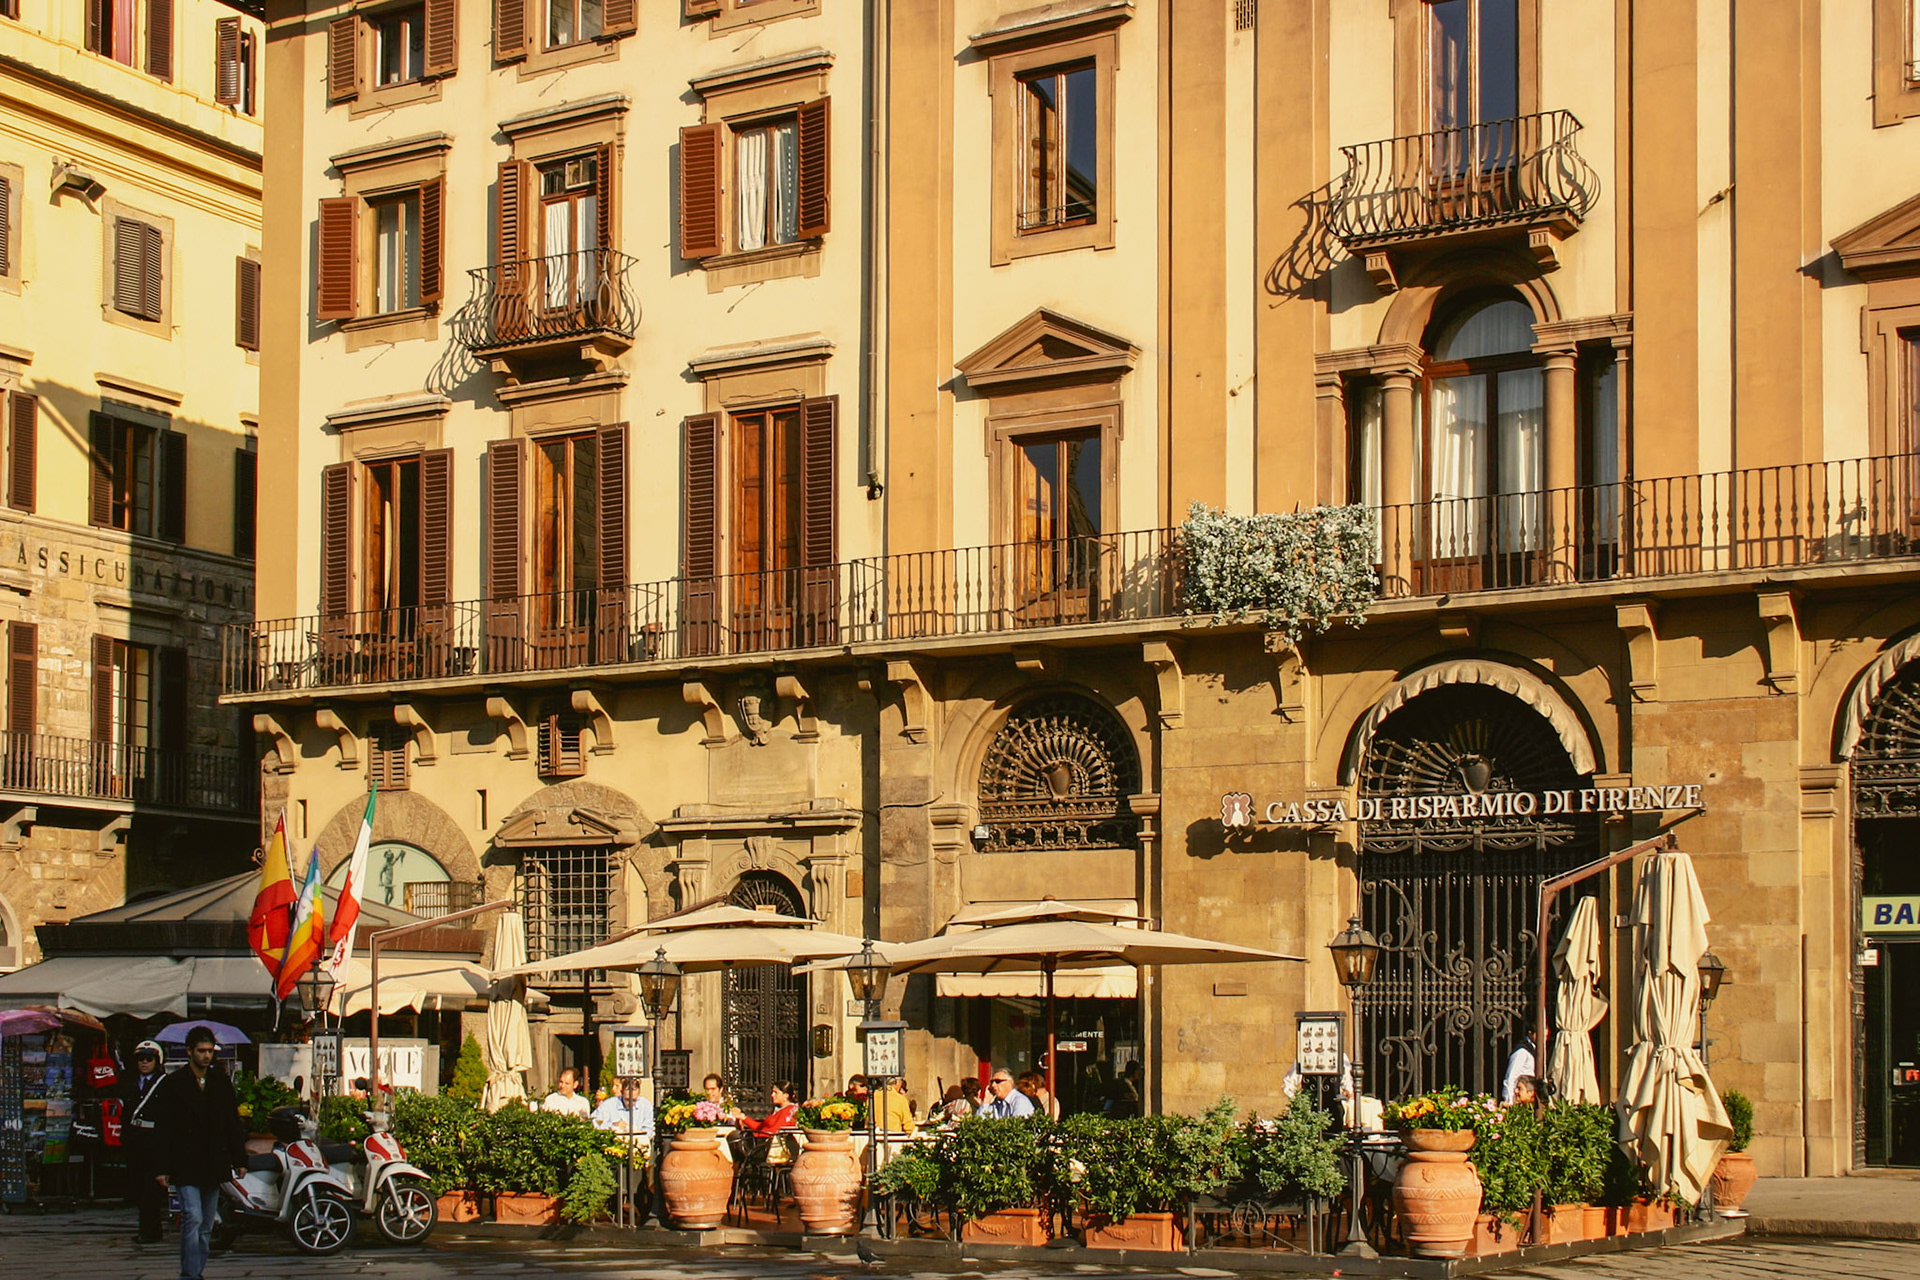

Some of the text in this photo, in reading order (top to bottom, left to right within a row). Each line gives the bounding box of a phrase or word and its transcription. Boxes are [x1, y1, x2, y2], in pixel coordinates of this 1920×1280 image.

[17, 542, 248, 607] ASSICURAZIONI
[1265, 784, 1703, 823] CASSA DI RISPARMIO DI FIRENZE
[1874, 903, 1920, 925] BA
